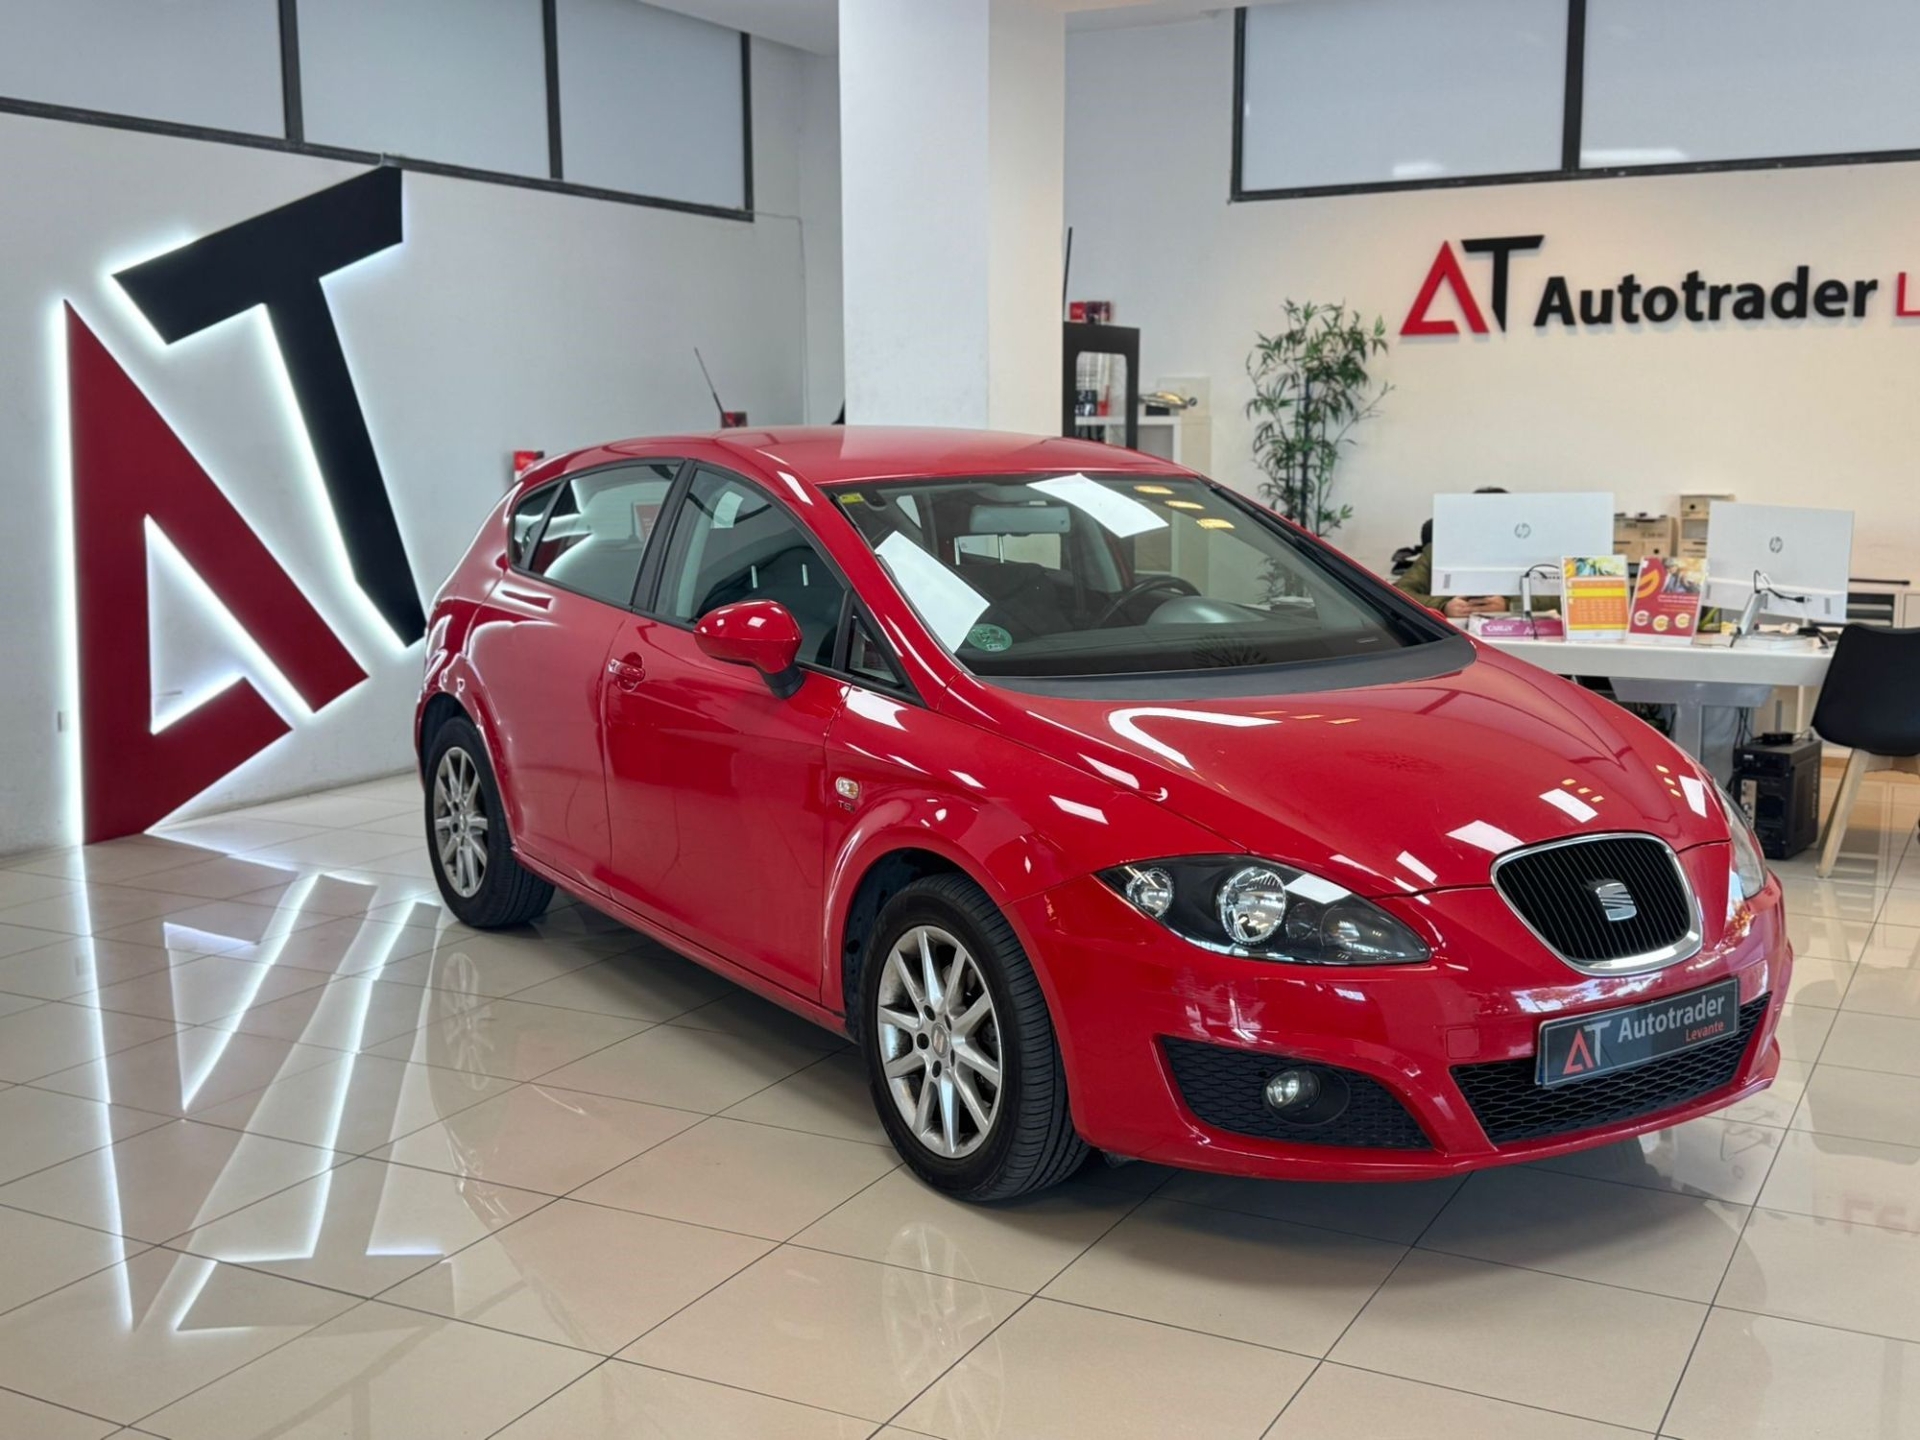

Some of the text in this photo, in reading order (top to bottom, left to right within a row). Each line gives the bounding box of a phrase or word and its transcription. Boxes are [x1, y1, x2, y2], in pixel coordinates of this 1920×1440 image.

[1400, 234, 1545, 335] AT
[1534, 265, 1878, 326] Autotrader
[63, 166, 427, 845] AT
[1562, 995, 1725, 1075] AT Autotrader
[1685, 1020, 1725, 1042] Levante
